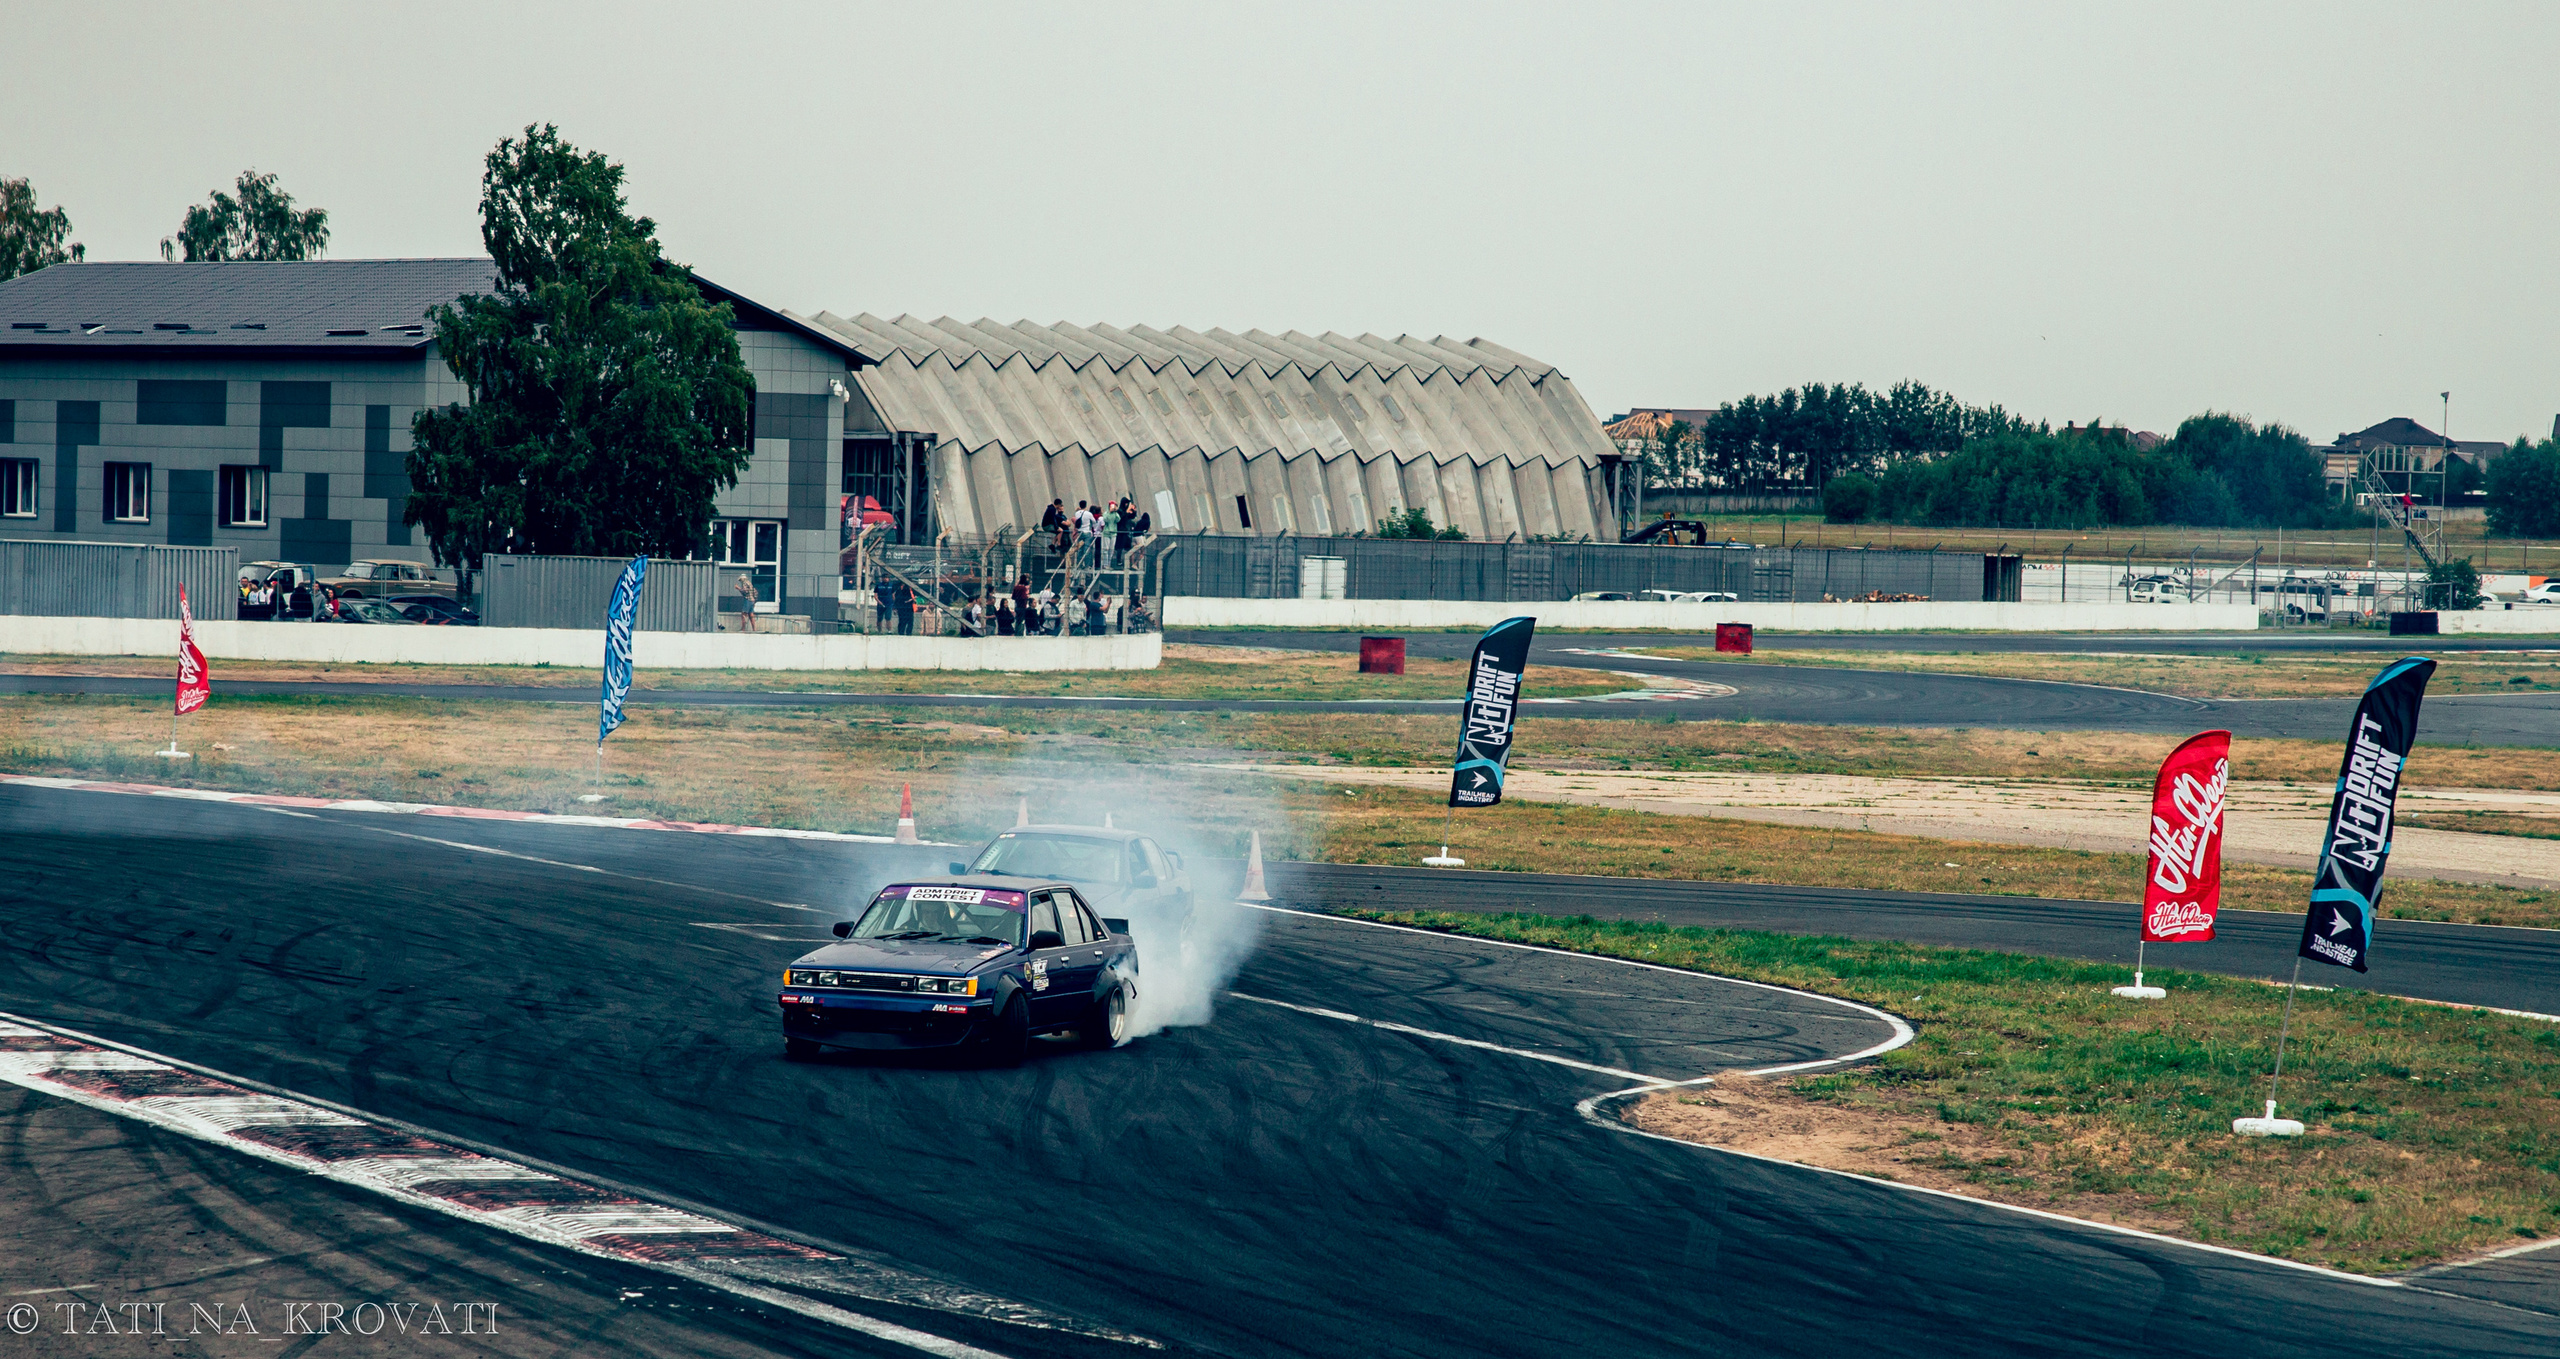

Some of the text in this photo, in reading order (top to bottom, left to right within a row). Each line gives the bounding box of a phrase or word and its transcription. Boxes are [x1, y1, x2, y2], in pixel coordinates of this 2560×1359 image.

[2325, 571, 2347, 580] ADM
[1472, 650, 1500, 702] DRIFT
[1492, 670, 1517, 705] FUN
[2345, 712, 2382, 797] DRIFT
[2370, 747, 2402, 806] FUN
[1458, 790, 1496, 799] TRAILHEAD
[912, 893, 978, 901] CONTEST
[2314, 933, 2358, 958] TRAILHEAD
